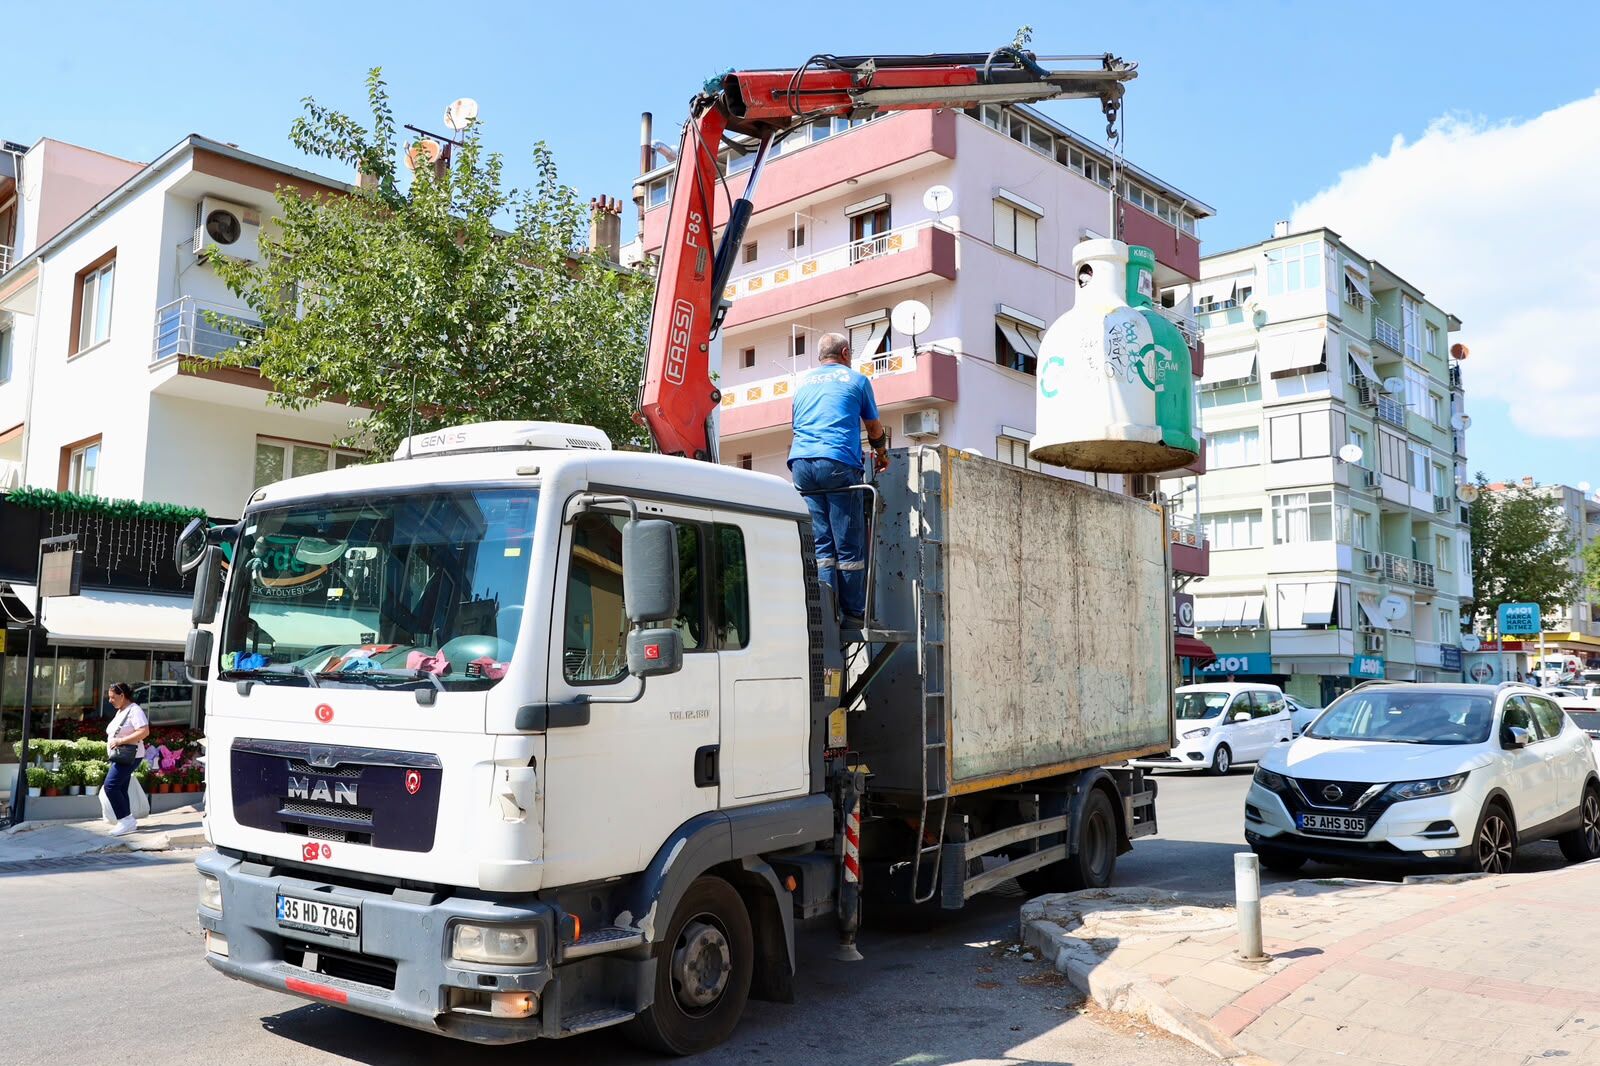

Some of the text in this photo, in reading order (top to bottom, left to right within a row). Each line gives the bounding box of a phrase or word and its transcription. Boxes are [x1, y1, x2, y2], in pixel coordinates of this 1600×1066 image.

[686, 212, 702, 248] F85
[667, 305, 692, 379] FASSI
[1158, 360, 1179, 371] CAM
[287, 776, 359, 806] MAN
[1303, 815, 1365, 831] 35 AHS 905
[285, 900, 299, 919] 35
[303, 902, 319, 923] HD
[322, 906, 355, 931] 7846
